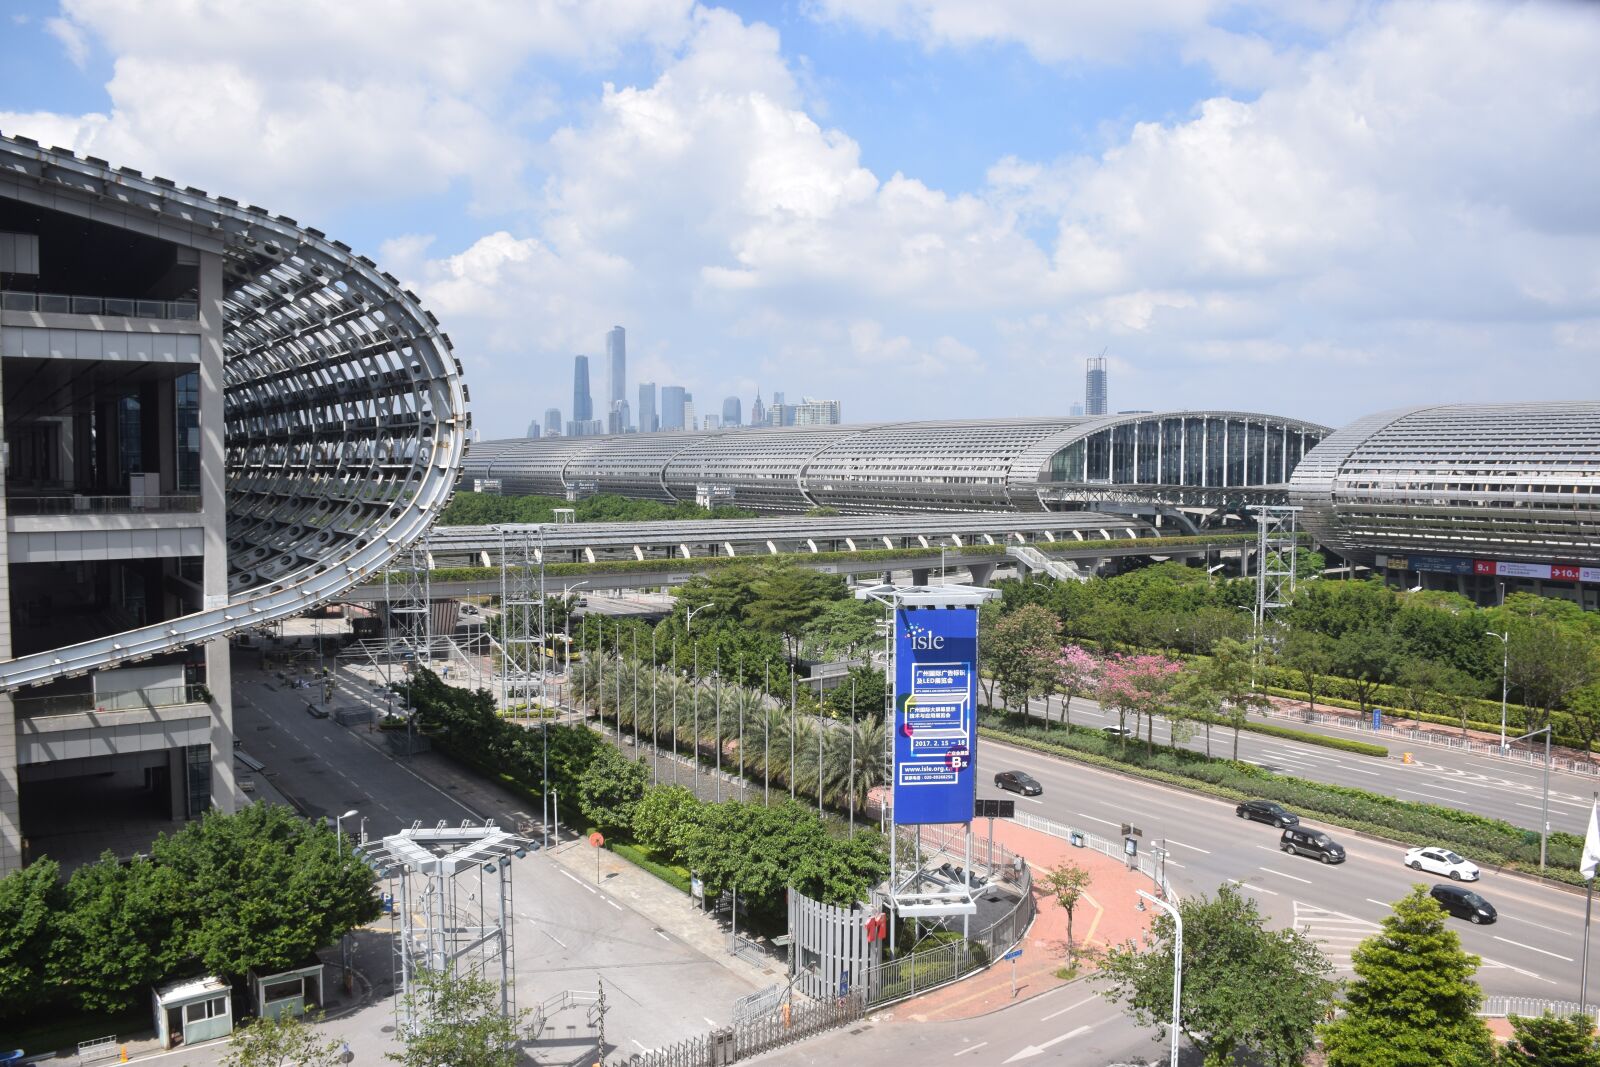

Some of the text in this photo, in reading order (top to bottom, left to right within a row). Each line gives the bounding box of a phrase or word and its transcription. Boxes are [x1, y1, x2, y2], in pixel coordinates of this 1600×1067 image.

[1477, 564, 1489, 572] 9.1
[1561, 569, 1579, 578] 10.1
[911, 630, 945, 650] isle
